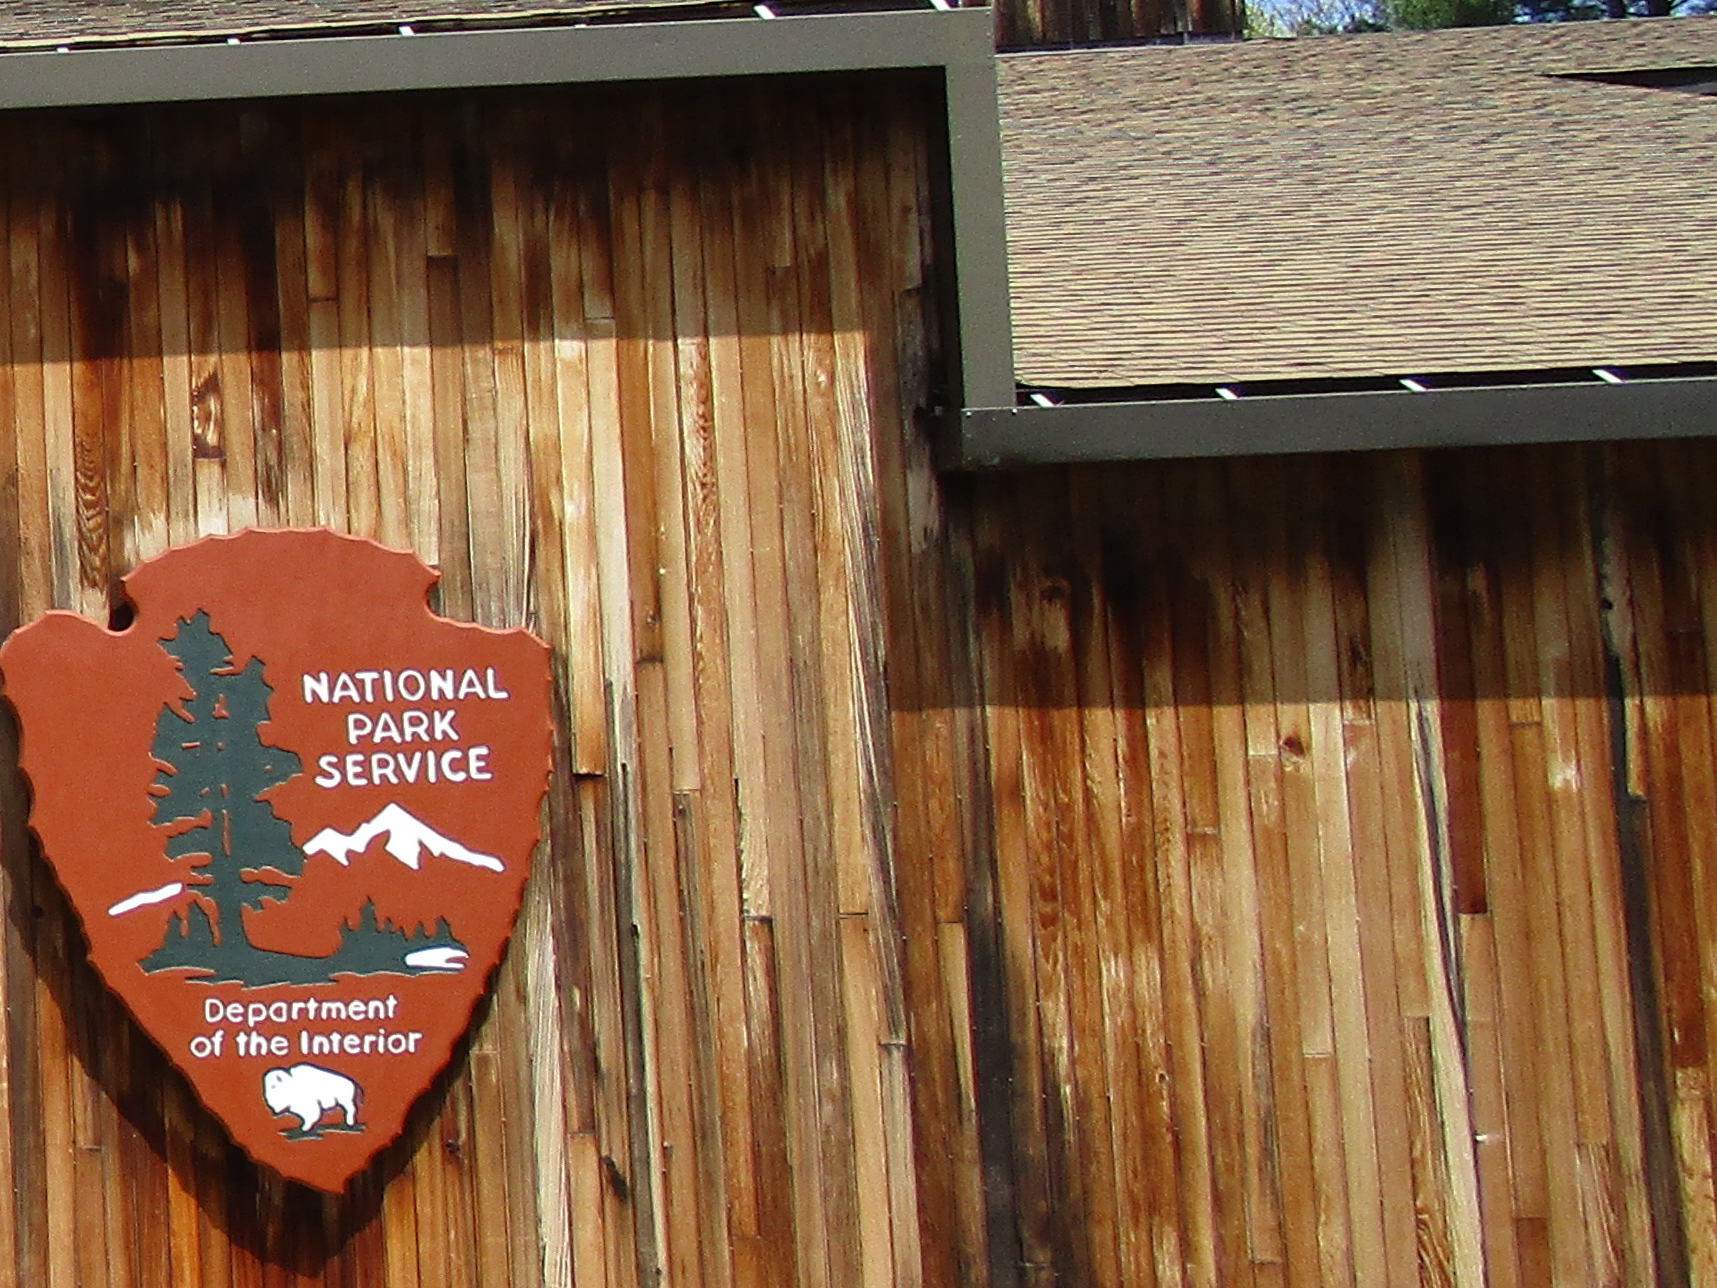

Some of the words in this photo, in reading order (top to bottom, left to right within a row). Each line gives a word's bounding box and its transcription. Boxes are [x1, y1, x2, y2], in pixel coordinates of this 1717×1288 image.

[301, 666, 510, 705] NATIONAL
[346, 708, 461, 745] PARK
[313, 745, 494, 789] SERVICE
[203, 994, 399, 1029] Department
[189, 1029, 226, 1059] of
[234, 1030, 290, 1057] the
[299, 1029, 424, 1056] Interior
